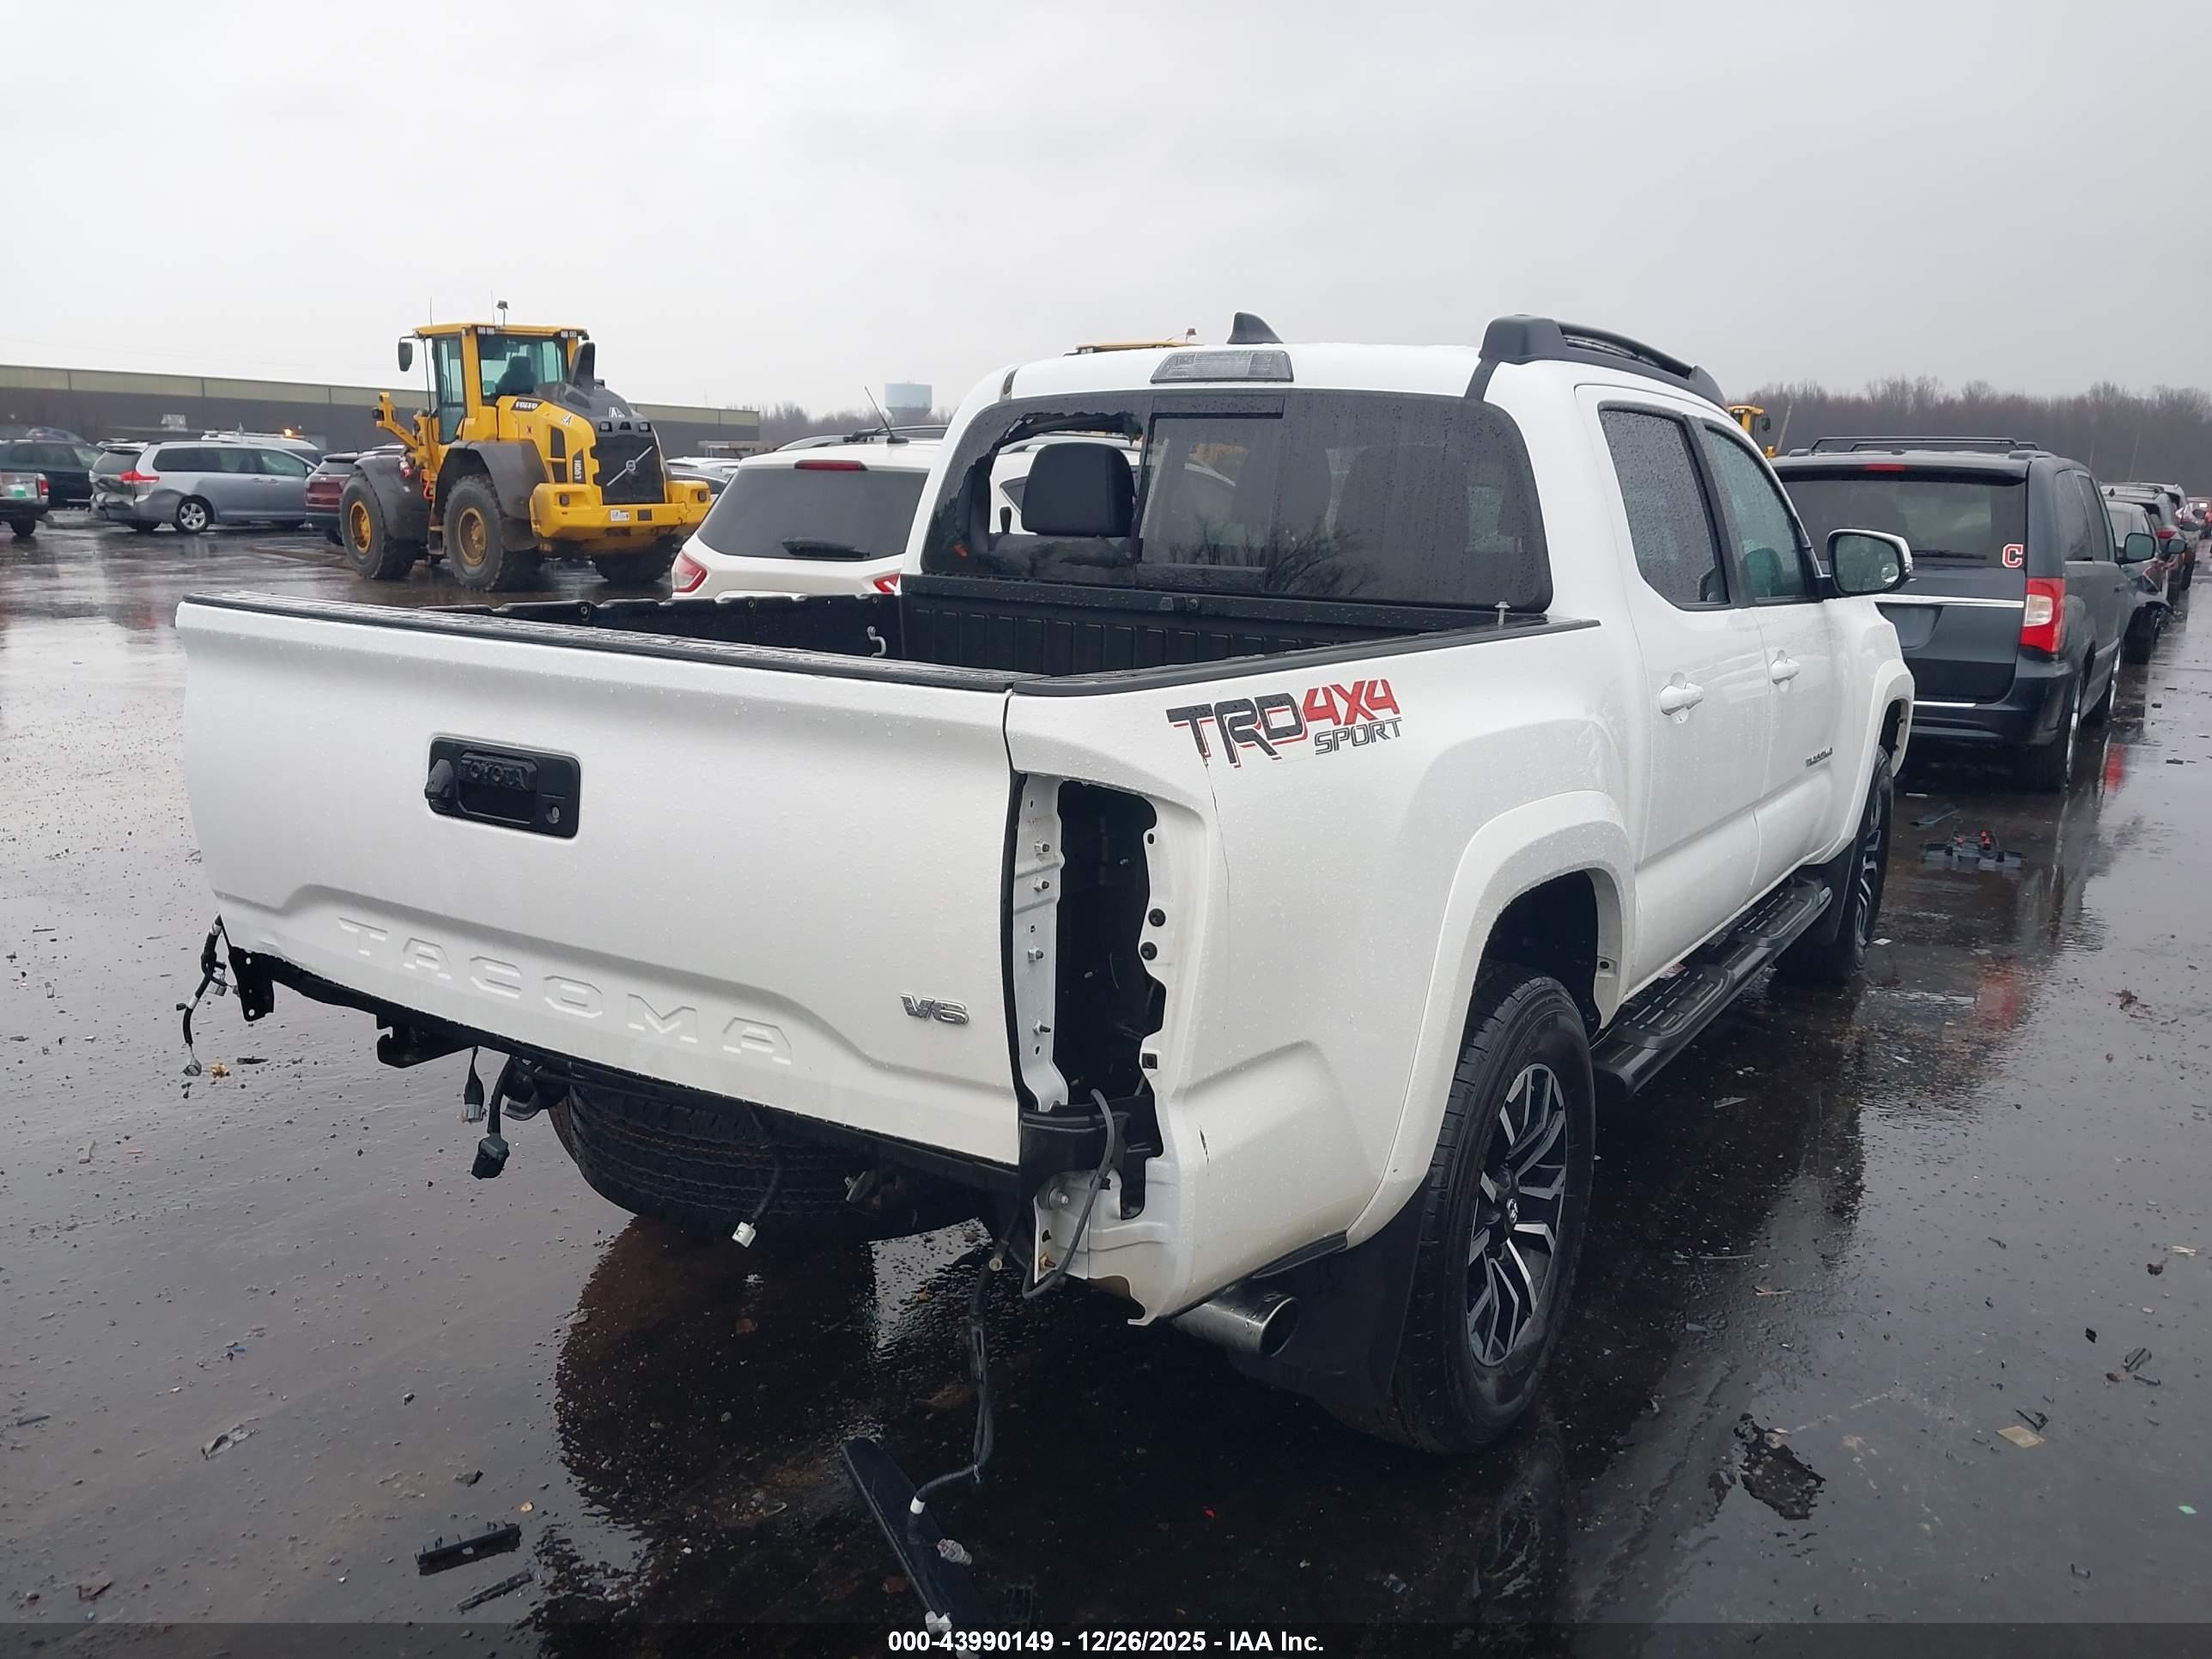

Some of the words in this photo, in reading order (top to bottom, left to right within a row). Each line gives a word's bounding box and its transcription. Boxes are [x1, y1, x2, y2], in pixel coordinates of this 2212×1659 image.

[2002, 543, 2024, 568] C
[1166, 693, 1308, 769] TRD
[1314, 716, 1402, 756] SPORT
[459, 759, 531, 792] TOYOTA
[337, 916, 793, 1066] TACOMA
[900, 992, 969, 1026] V6
